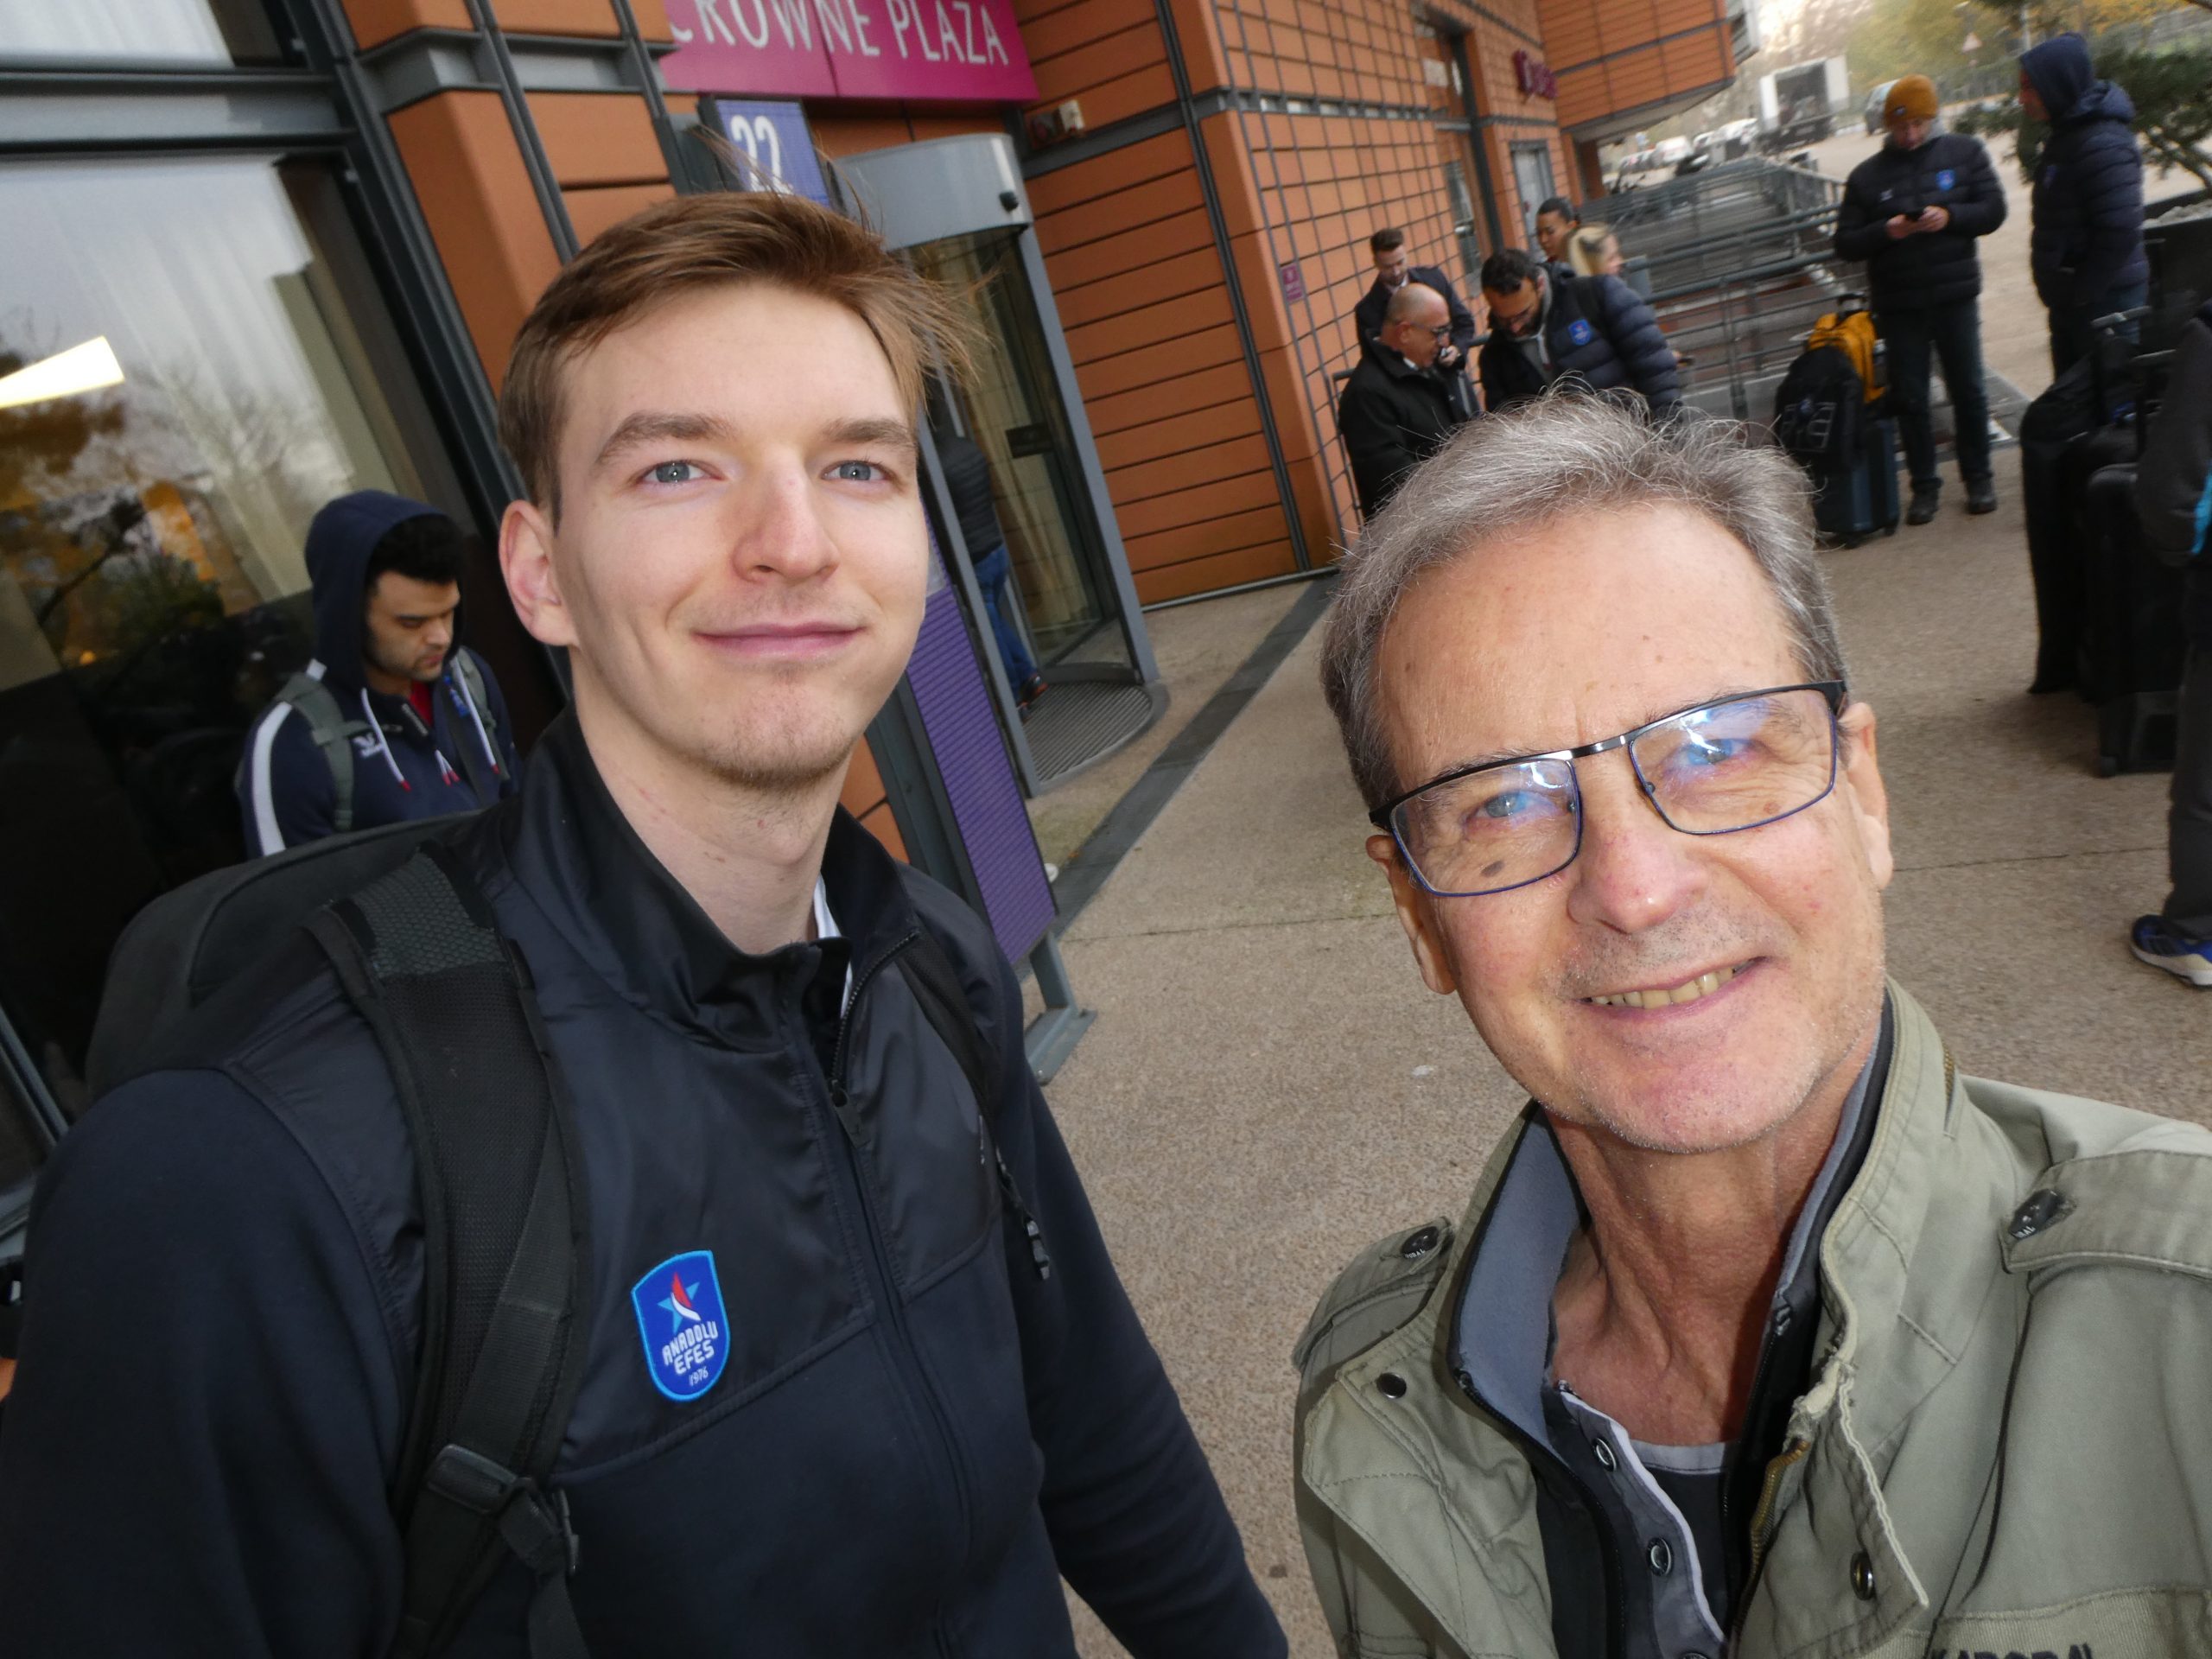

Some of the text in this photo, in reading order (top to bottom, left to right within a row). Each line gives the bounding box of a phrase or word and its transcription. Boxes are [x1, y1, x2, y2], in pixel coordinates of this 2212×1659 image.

[886, 0, 1009, 66] PLAZA
[731, 114, 794, 197] 22
[662, 1320, 719, 1366] ANADOLU
[674, 1339, 715, 1375] EFES
[689, 1366, 709, 1386] 1976
